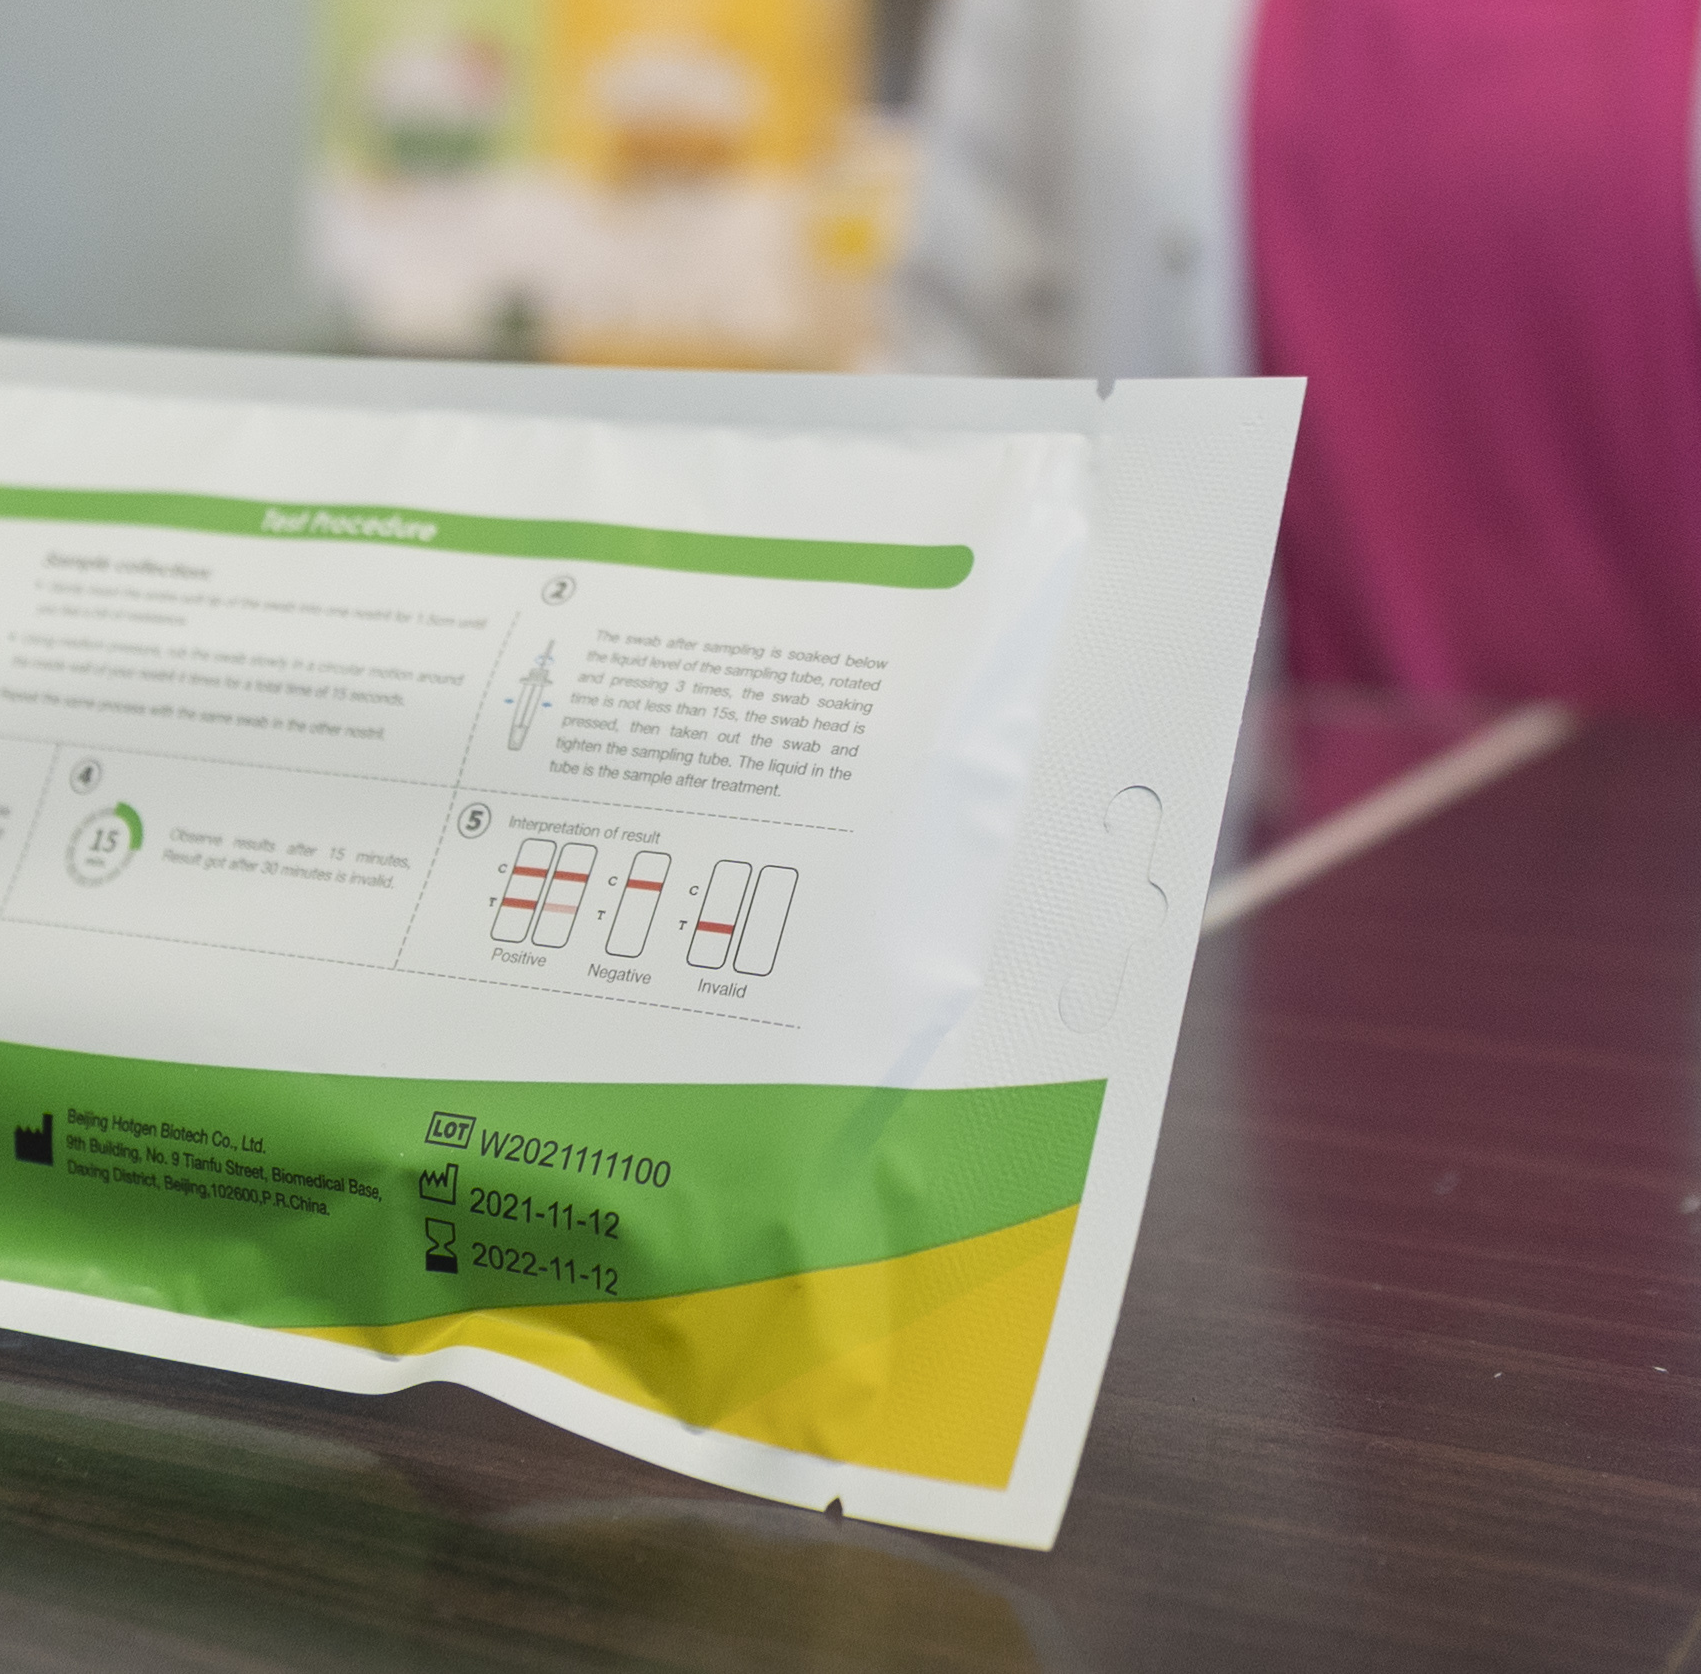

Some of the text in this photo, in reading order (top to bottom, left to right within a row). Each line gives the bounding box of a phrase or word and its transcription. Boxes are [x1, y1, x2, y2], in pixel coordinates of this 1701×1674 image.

[262, 507, 438, 542] Test Procedure
[598, 629, 889, 670] The swab after sampling is soaked below
[368, 666, 413, 680] motion
[416, 671, 465, 686] around
[586, 650, 883, 692] the liquid level of the sampling tube, rotated
[255, 679, 283, 694] total
[285, 682, 312, 697] time
[332, 687, 347, 700] 15
[349, 690, 405, 707] seconds.
[577, 672, 874, 716] and pressing 3 times, the swab soaking
[236, 715, 269, 729] swab
[272, 717, 284, 729] in
[287, 719, 306, 733] the
[308, 722, 341, 736] other
[570, 692, 866, 735] time is not less than 15s, the swab head is
[561, 716, 860, 758] pressed, then taken out the swab and
[556, 736, 853, 781] tighten the sampling tube. The liquid in the
[549, 760, 781, 797] tube is the sample after treatment.
[89, 829, 119, 853] 15
[508, 815, 662, 845] Interpretation of result
[169, 827, 410, 870] Observe results after 15 minutes,
[162, 848, 395, 889] Result got after 30 minutes is invalid.
[497, 863, 508, 874] C
[607, 875, 619, 887] C
[488, 897, 498, 908] T
[688, 885, 700, 897] C
[597, 910, 606, 921] T
[679, 920, 688, 931] T
[490, 947, 548, 968] Positive
[586, 963, 653, 985] Negative
[697, 978, 748, 999] Invalid
[67, 1108, 267, 1154] Beijing Hotgen Biotech Co., Ltd.
[66, 1134, 383, 1204] 9th Building, No. 9 Tianfu Street, Biomedical Base,
[433, 1119, 671, 1188] LOT W2021111100
[67, 1160, 110, 1183] Daxing
[112, 1167, 161, 1190] District,
[470, 1187, 620, 1240] 2021-11-12
[471, 1242, 618, 1296] 2022-11-12
